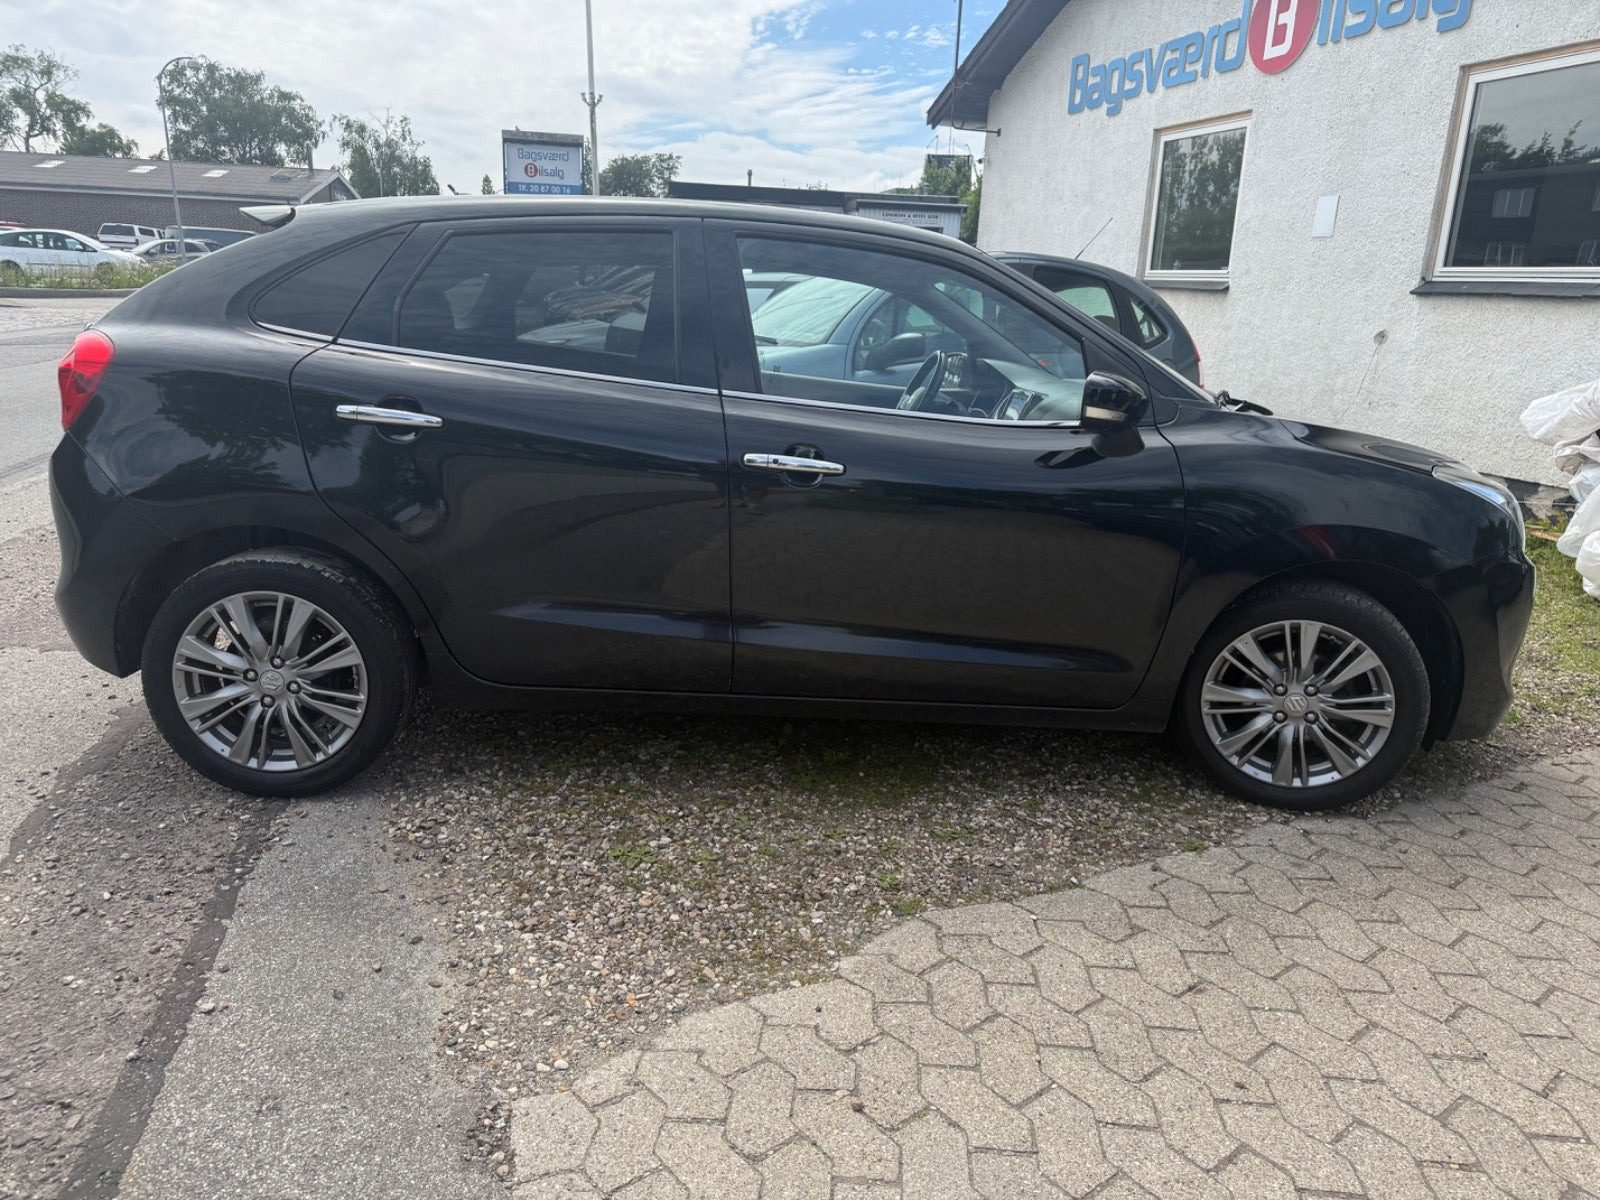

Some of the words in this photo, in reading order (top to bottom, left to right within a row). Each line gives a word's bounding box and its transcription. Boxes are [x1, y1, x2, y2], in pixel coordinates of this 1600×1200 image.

[1068, 0, 1251, 117] Bagsværd
[1262, 0, 1473, 60] Bils
[517, 148, 570, 162] Bagsværd
[526, 163, 565, 180] Bilsalg
[530, 184, 539, 193] 20
[551, 185, 560, 194] 00
